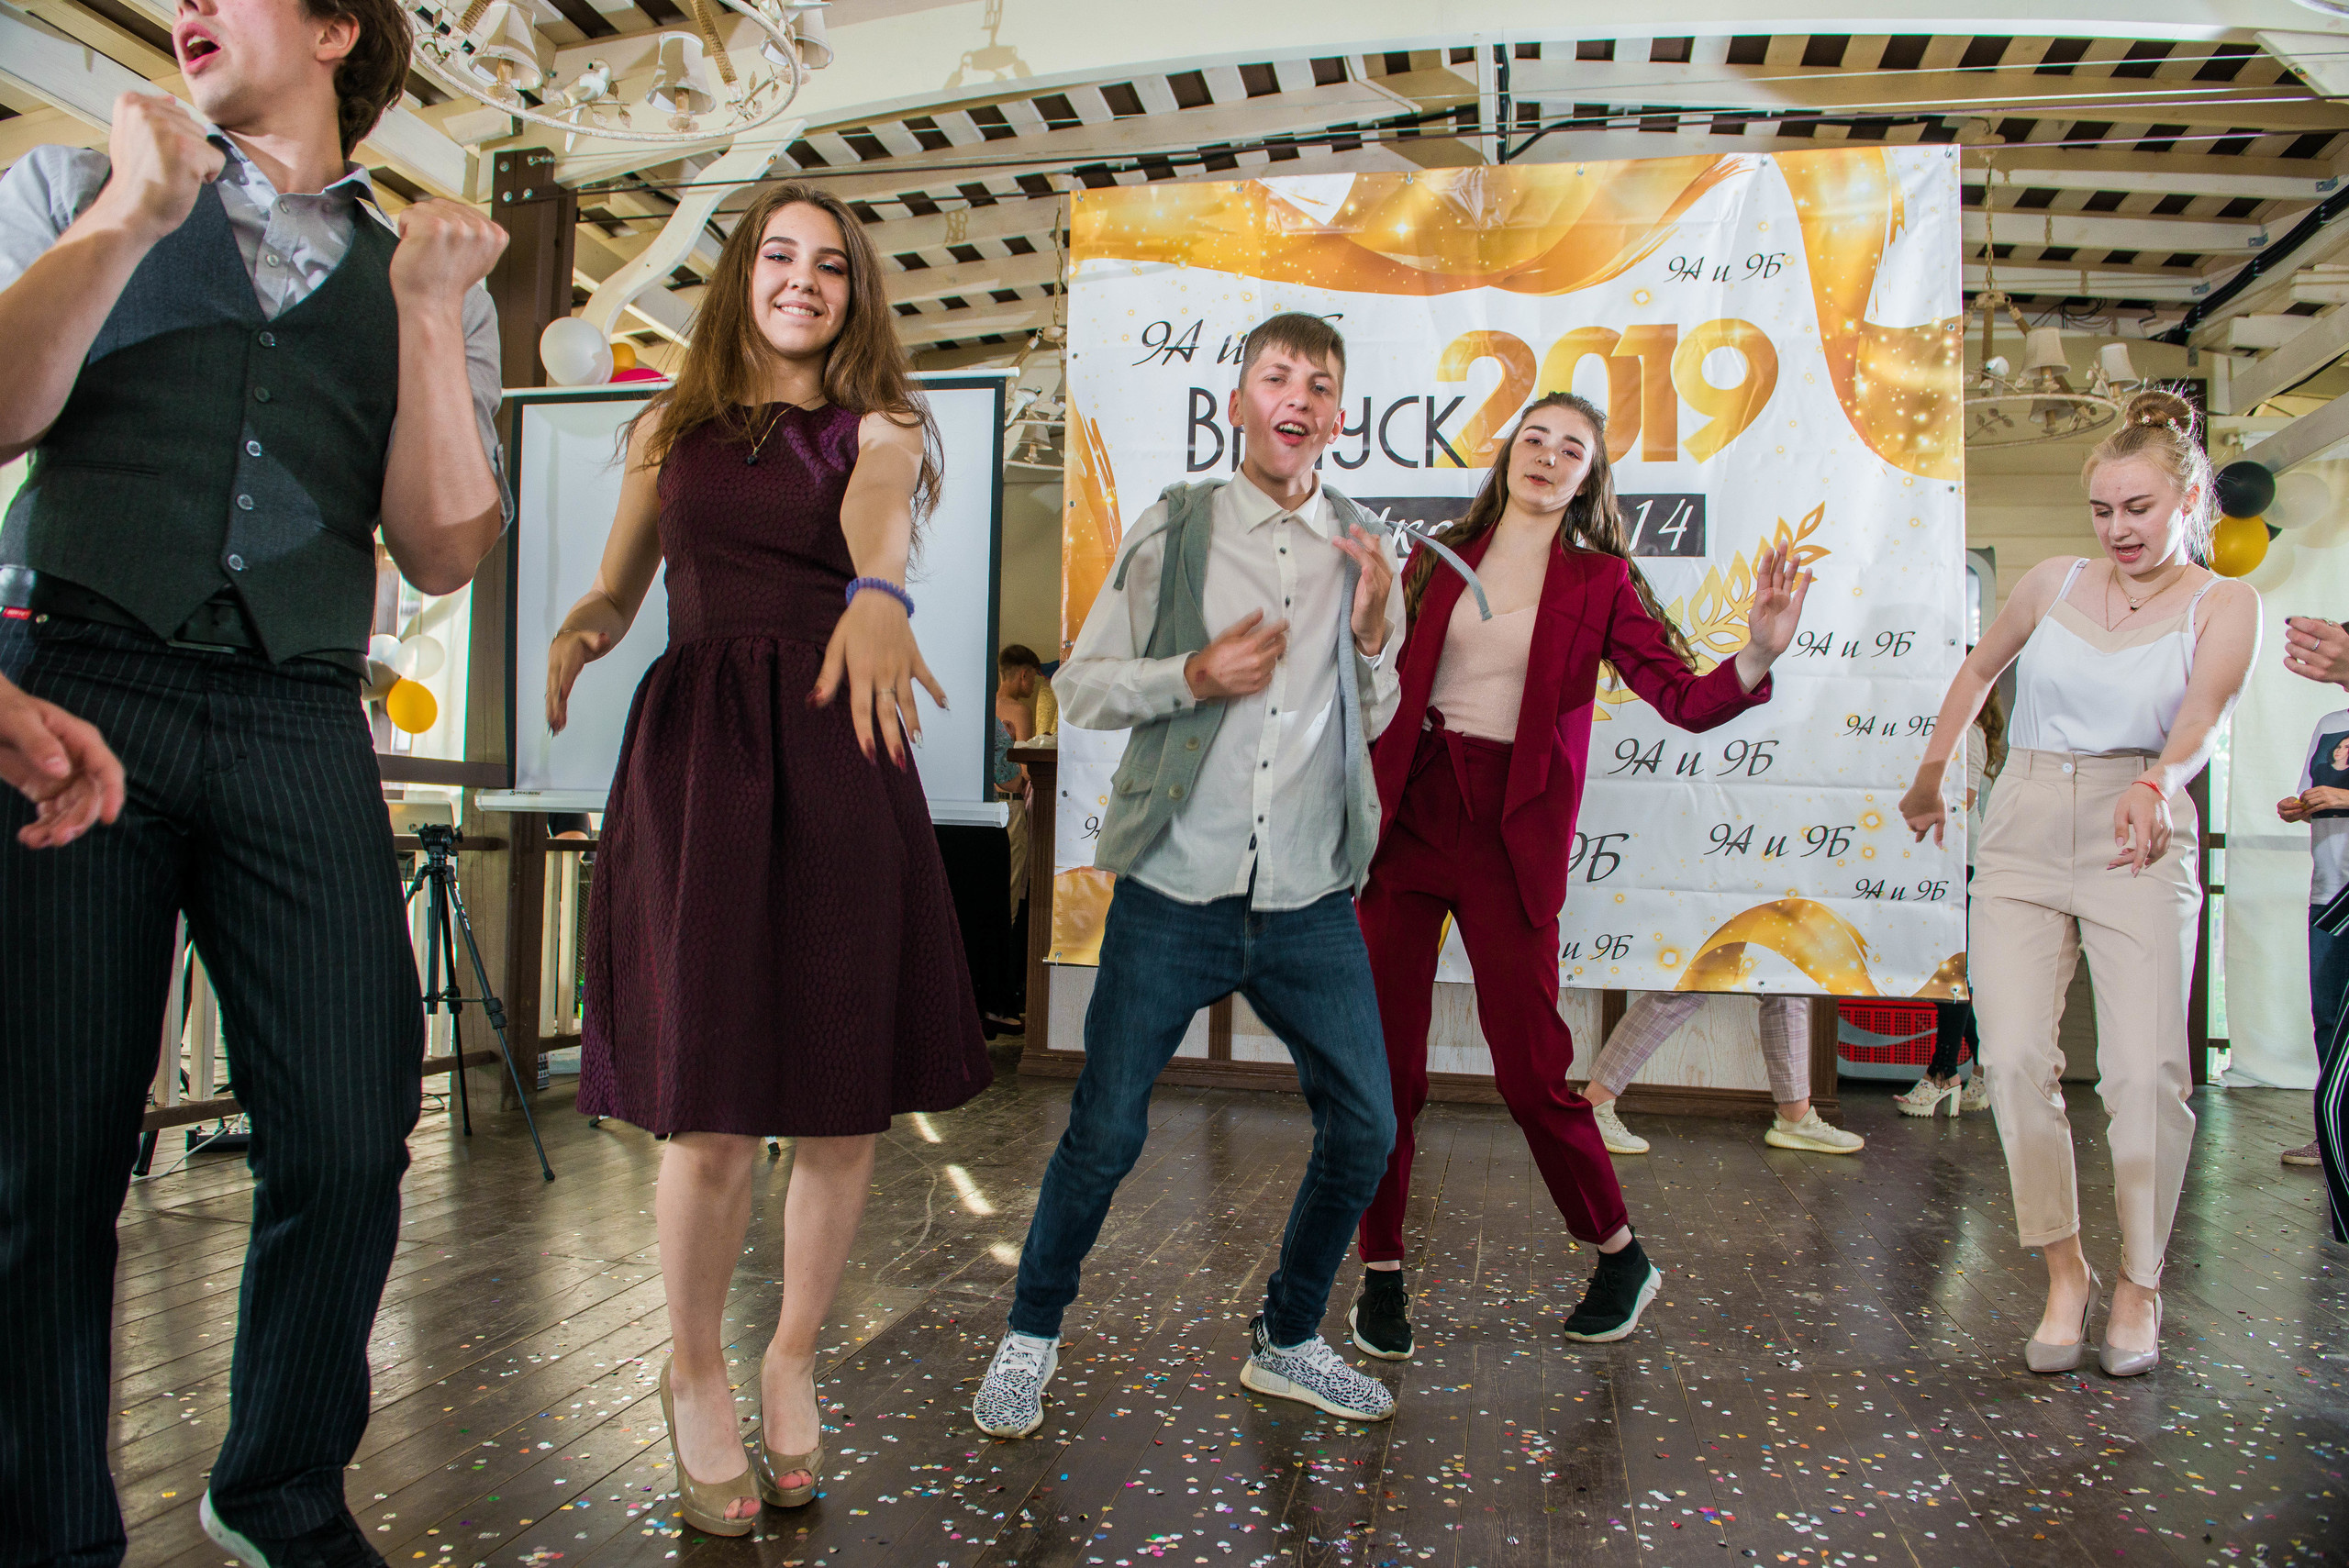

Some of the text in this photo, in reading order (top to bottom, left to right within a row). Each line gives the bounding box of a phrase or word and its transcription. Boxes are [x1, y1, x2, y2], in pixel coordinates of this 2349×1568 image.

[1664, 252, 1786, 283] 9А и 9Б
[1132, 318, 1204, 366] 9А
[1186, 317, 1779, 473] ВУСК 2019
[1792, 630, 1916, 658] 9А и 9Б
[1842, 715, 1939, 737] 9А и 9Б
[1608, 738, 1779, 777] 9А и 9Б
[1703, 824, 1855, 858] 9А и 9Б
[1851, 878, 1949, 901] 9А и 9Б
[1562, 934, 1633, 961] и 9Б
